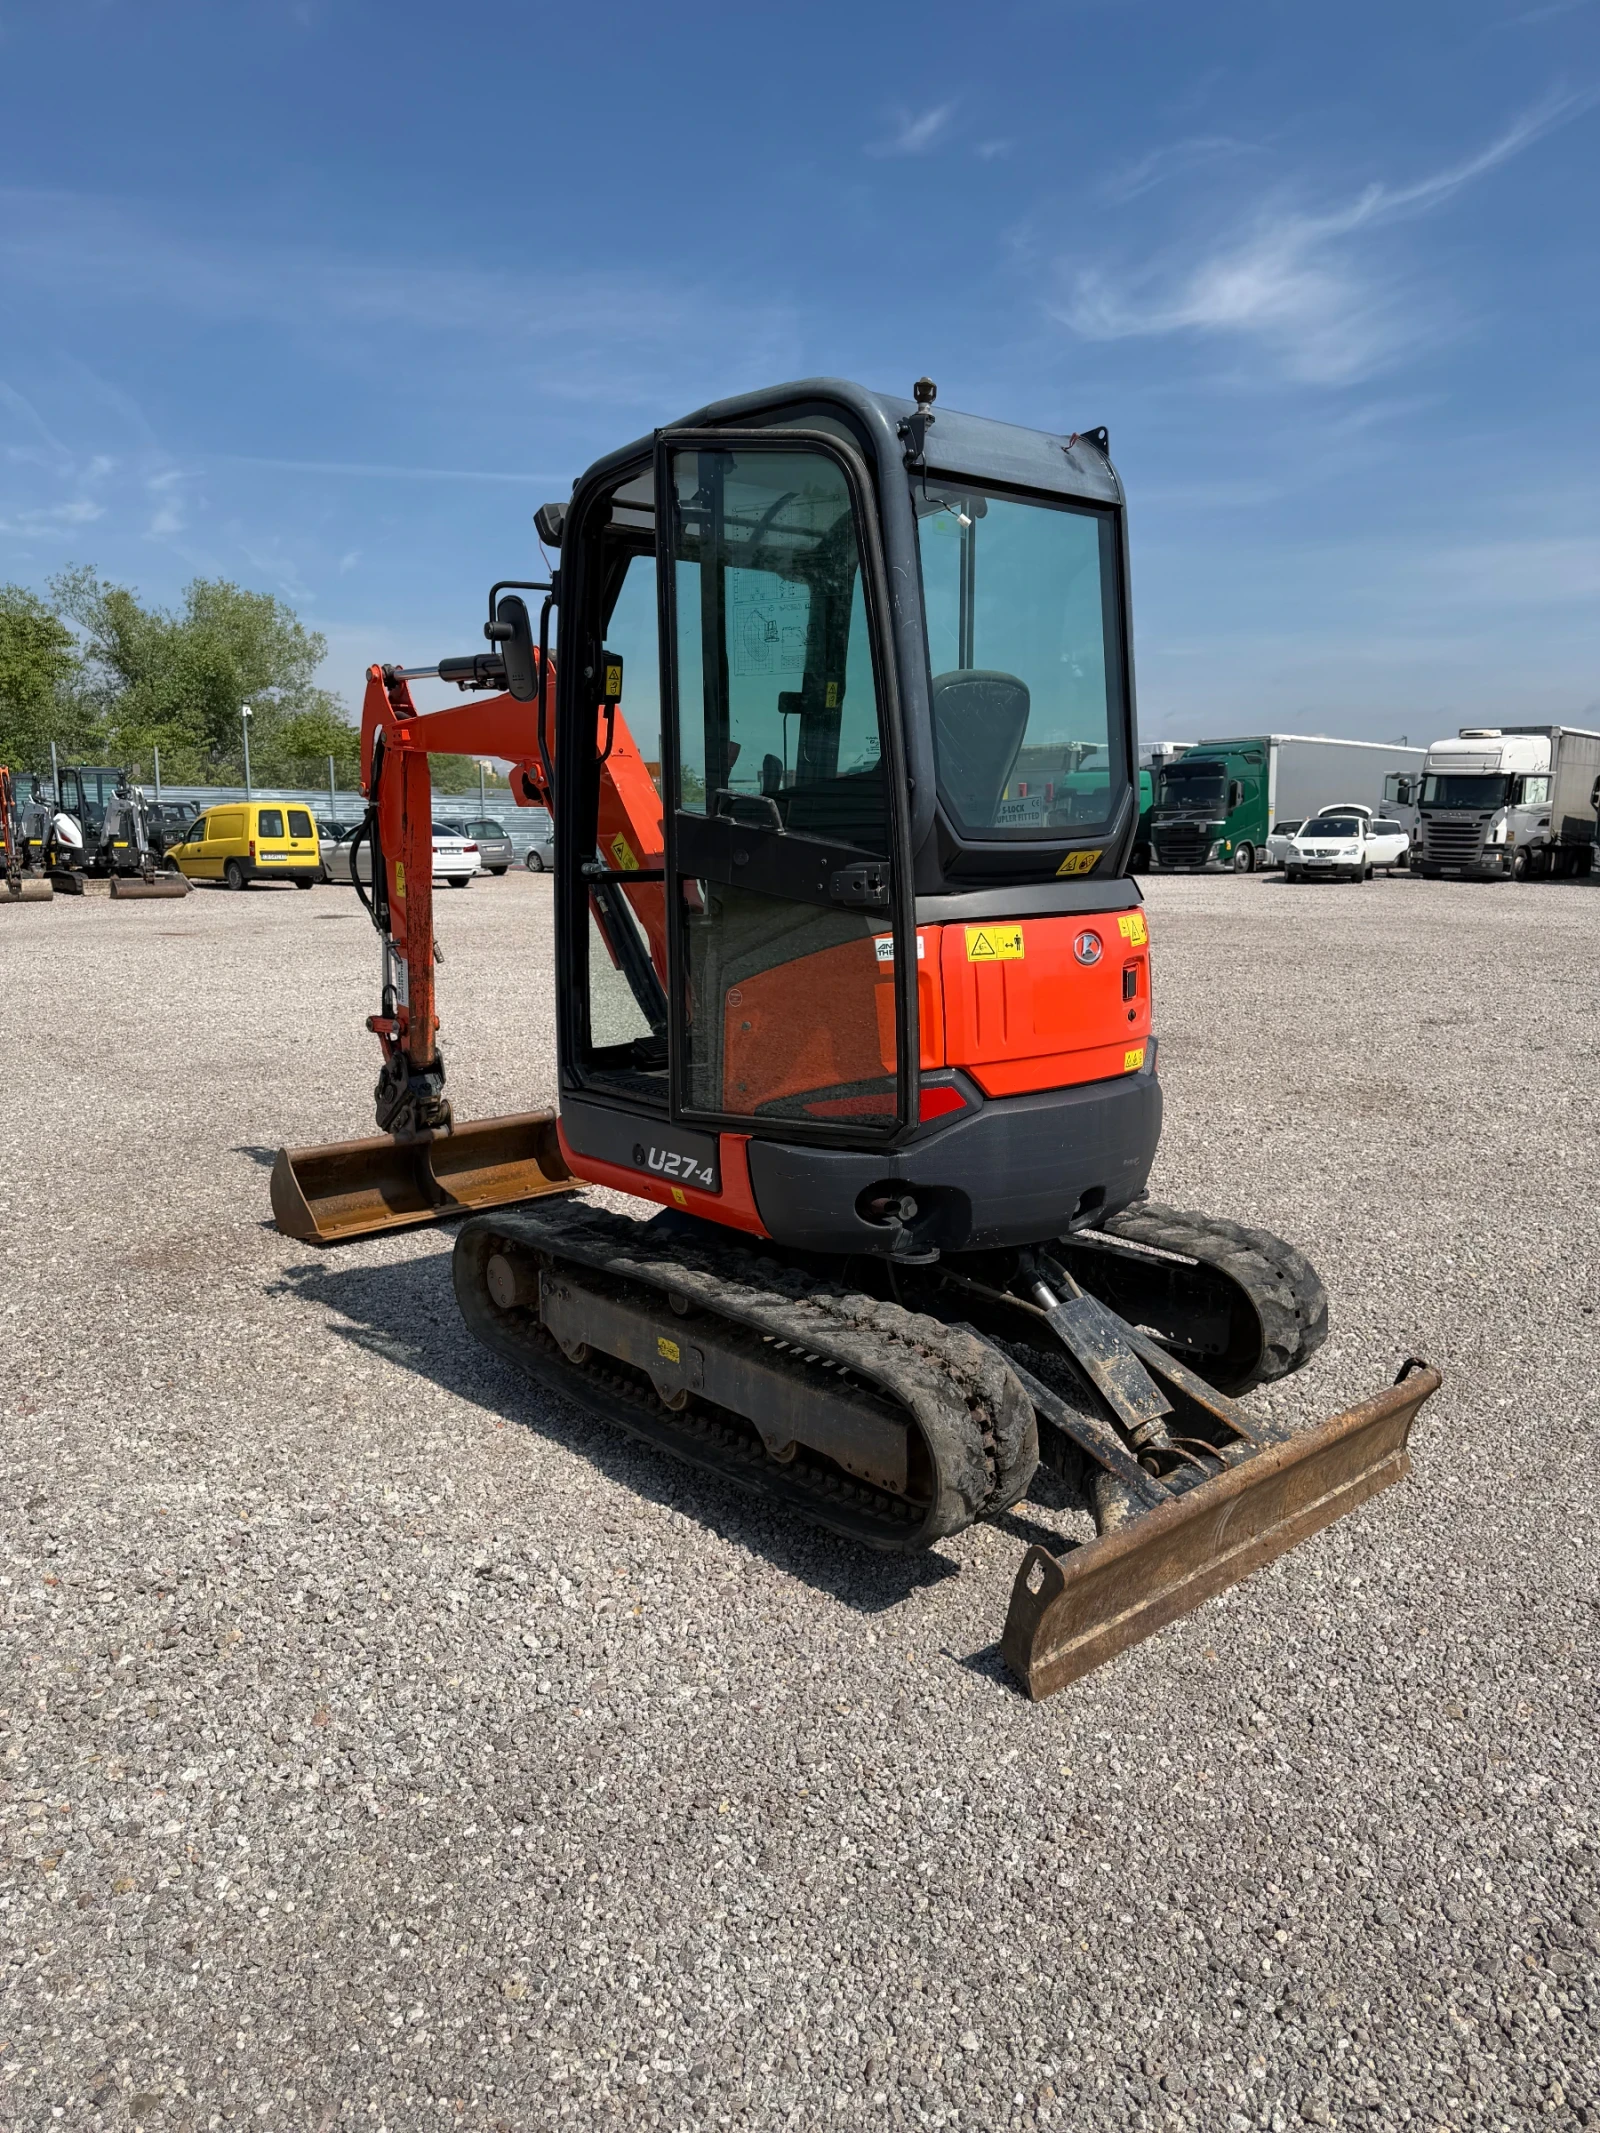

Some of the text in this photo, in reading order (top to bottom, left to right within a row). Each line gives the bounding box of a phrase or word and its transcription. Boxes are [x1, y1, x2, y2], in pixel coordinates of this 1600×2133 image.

[1002, 804, 1025, 814] S-LOCK
[1018, 812, 1040, 821] FITTED
[647, 1147, 713, 1186] U27-4
